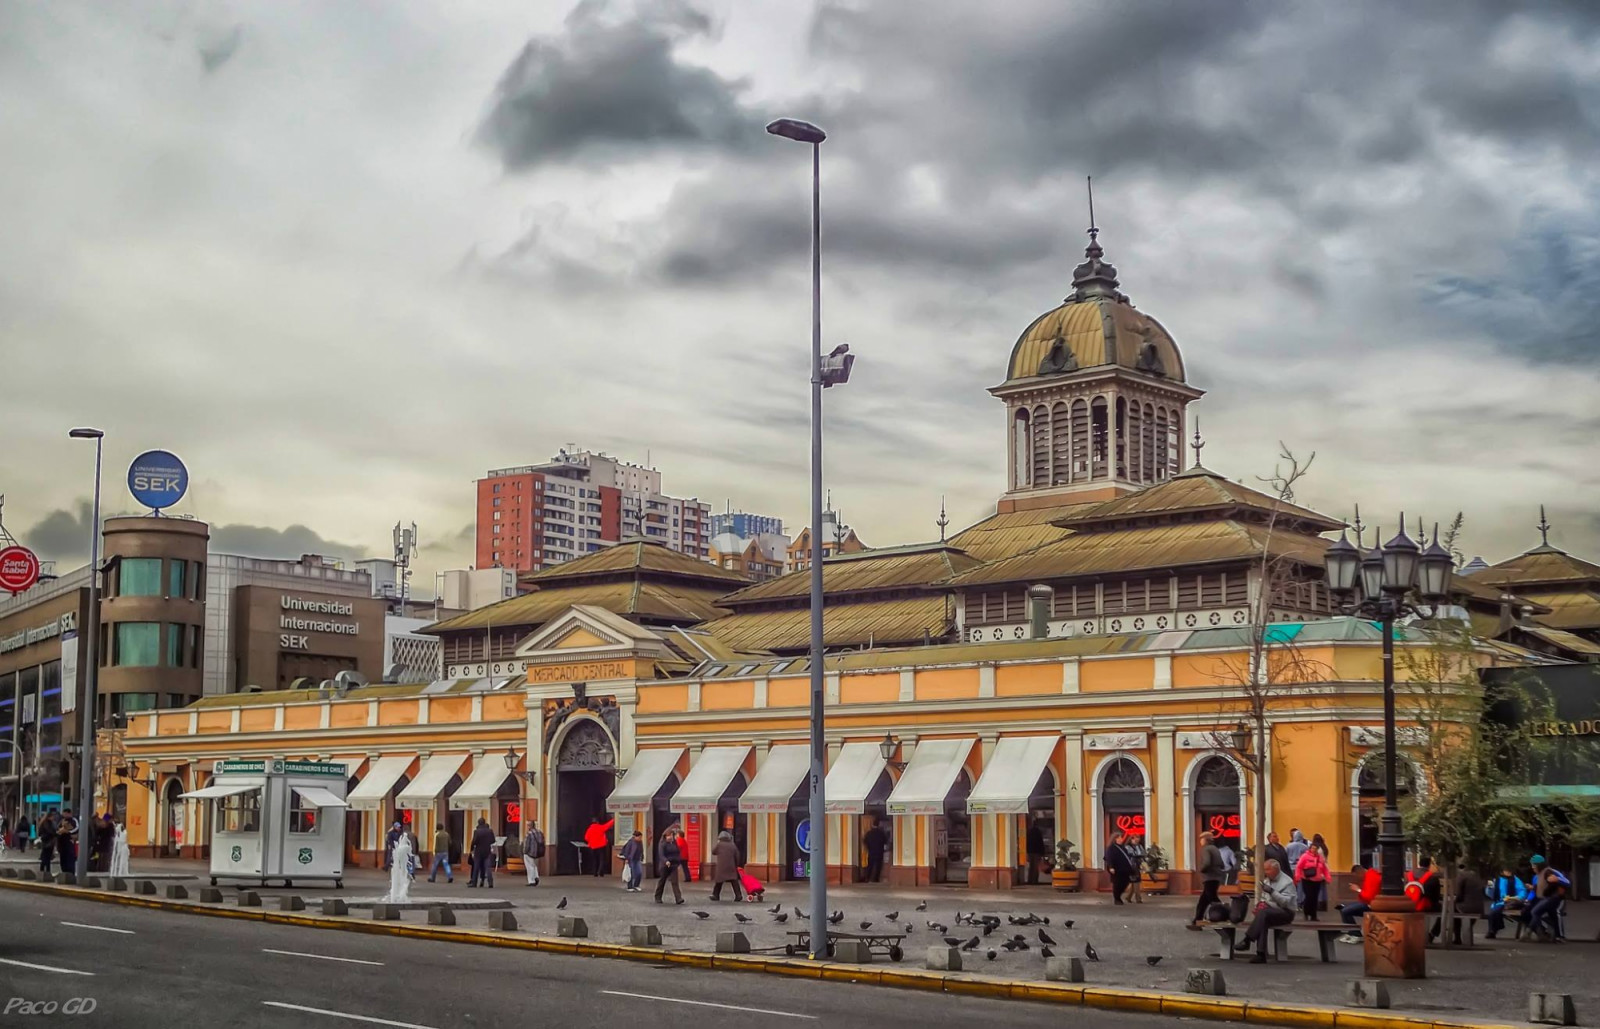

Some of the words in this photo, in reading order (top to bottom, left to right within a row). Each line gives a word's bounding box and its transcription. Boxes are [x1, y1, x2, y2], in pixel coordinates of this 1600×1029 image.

[133, 477, 180, 492] SEK
[5, 559, 29, 568] Santa
[281, 595, 353, 615] Universidad
[61, 611, 76, 633] SEK
[280, 615, 359, 635] Internacional
[280, 634, 309, 649] SEK
[534, 666, 578, 681] MERCADO
[582, 663, 628, 680] CENTRAL
[285, 764, 321, 772] CARABINEROS
[329, 766, 345, 774] CHILE
